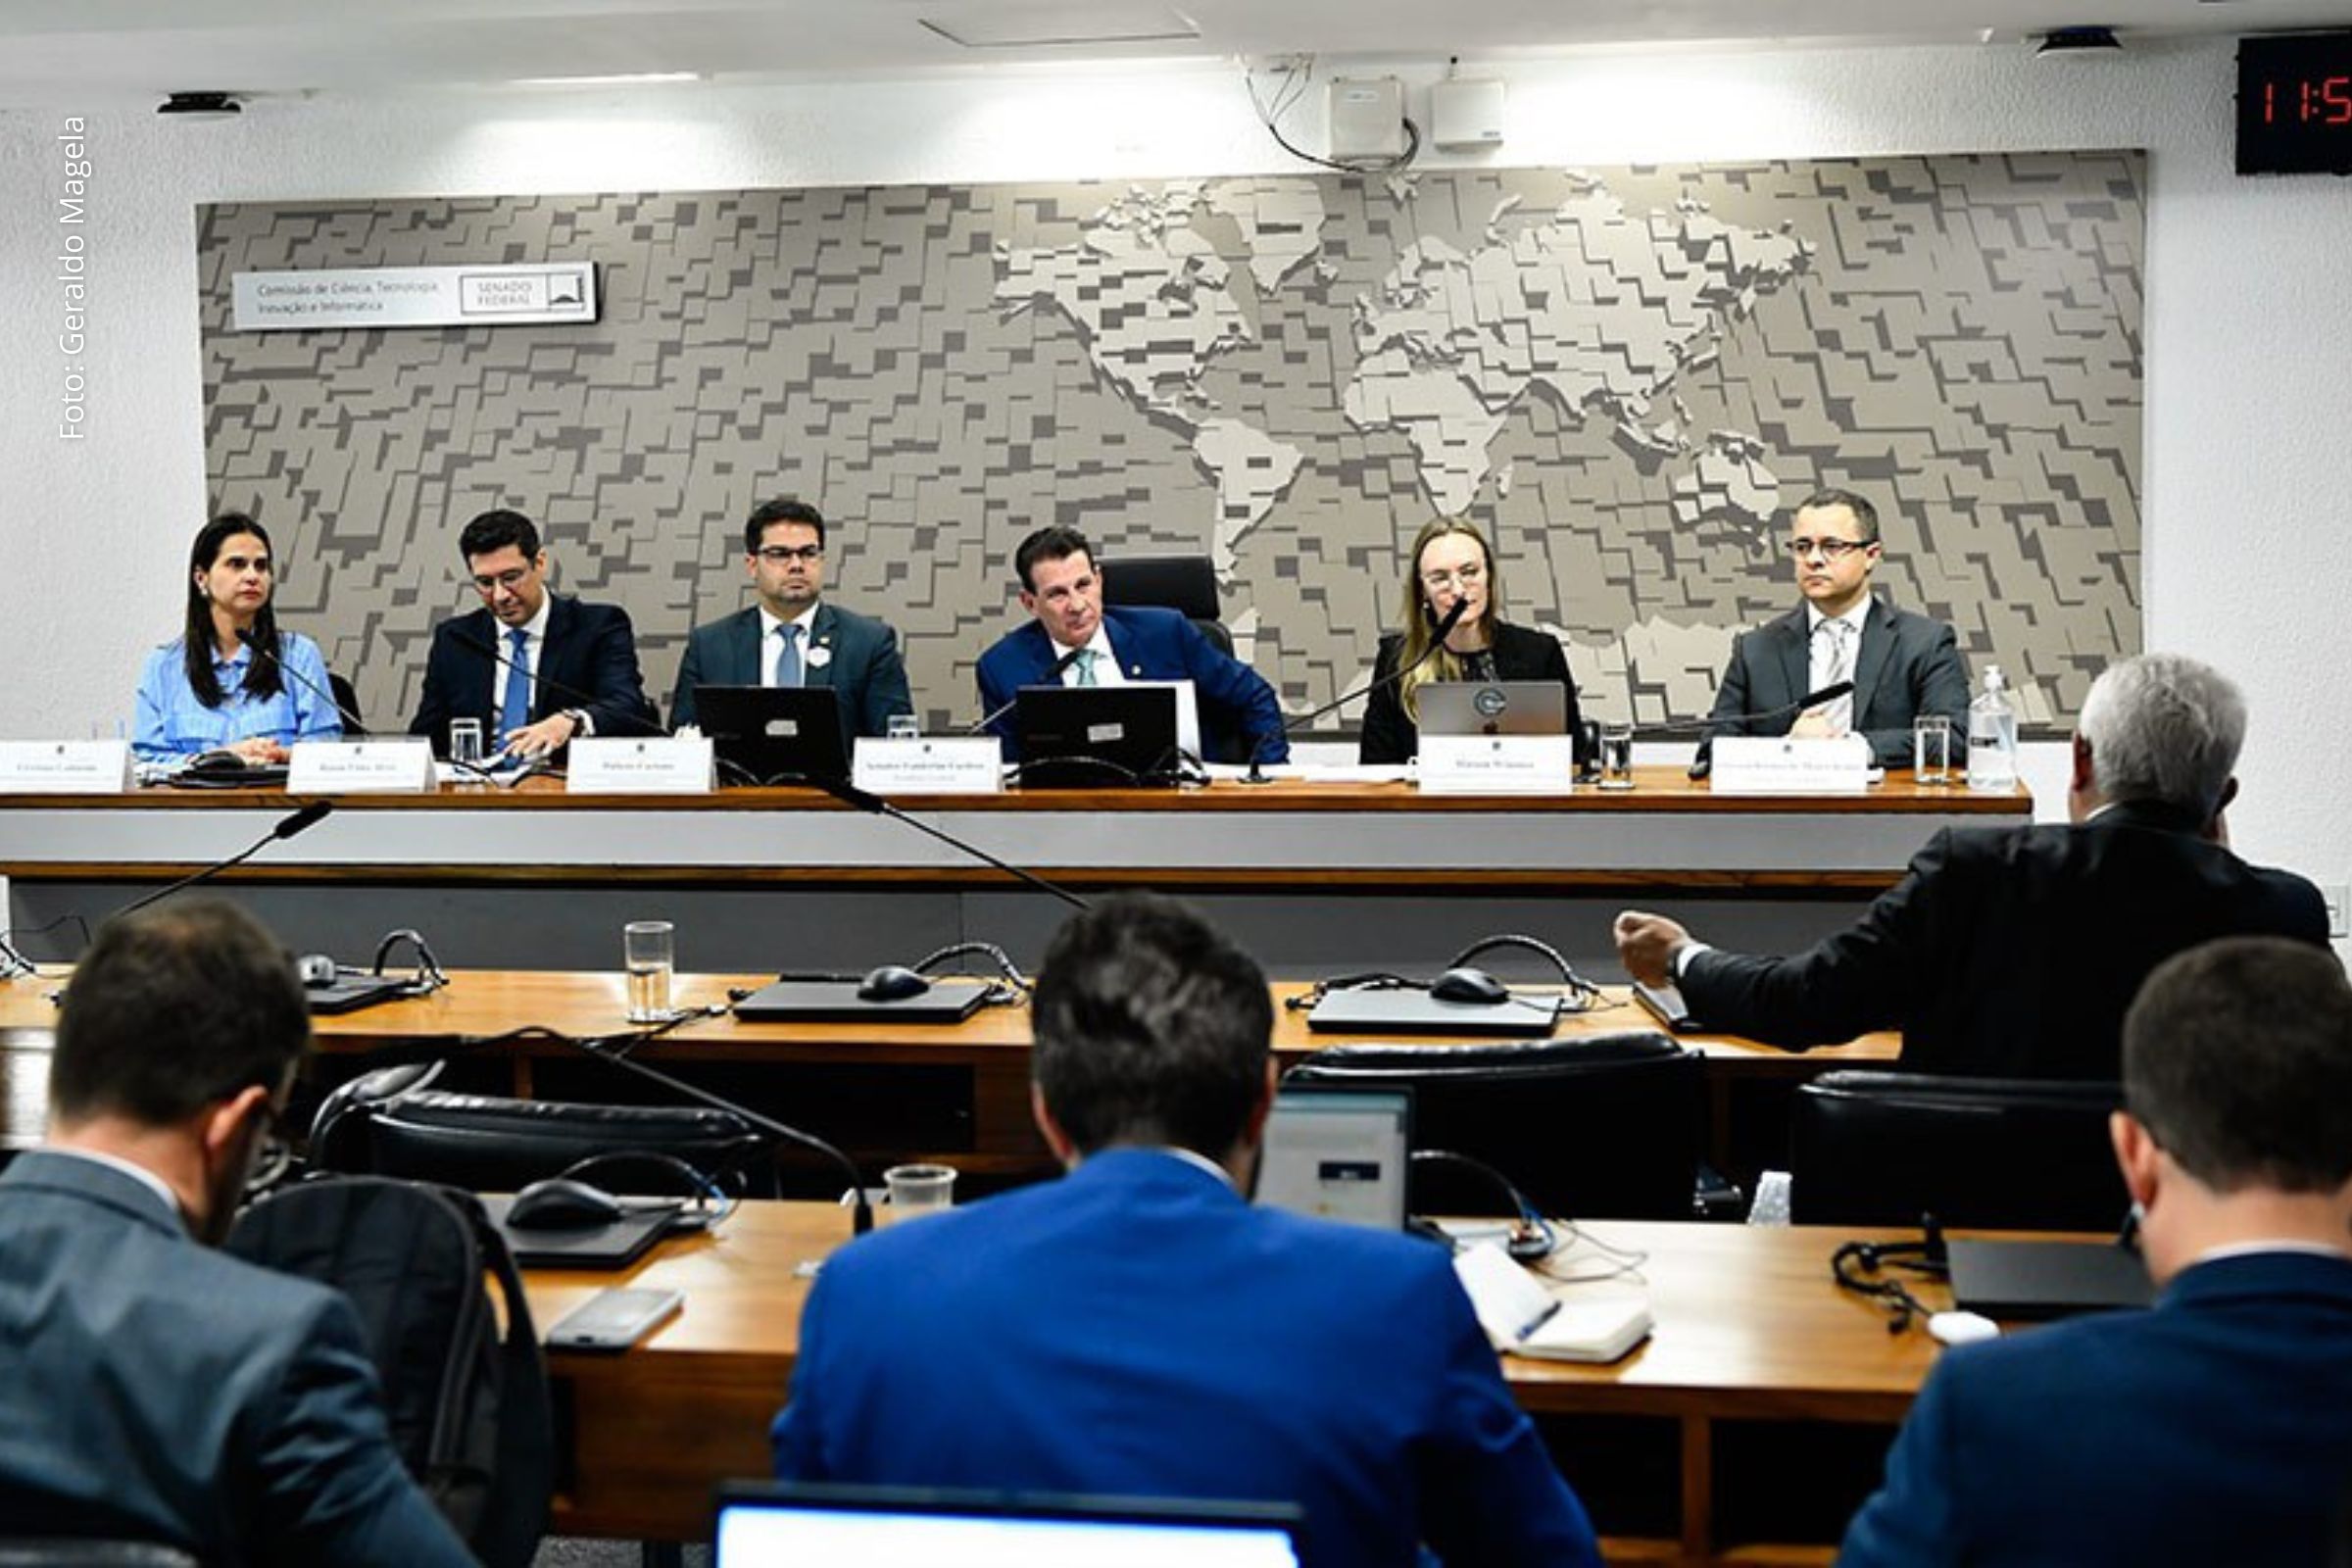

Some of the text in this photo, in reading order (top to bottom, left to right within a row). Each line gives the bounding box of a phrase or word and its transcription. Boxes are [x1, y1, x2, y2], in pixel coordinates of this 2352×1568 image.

[313, 282, 328, 294] de
[477, 281, 533, 292] SENADO
[477, 294, 530, 306] FEDERAL
